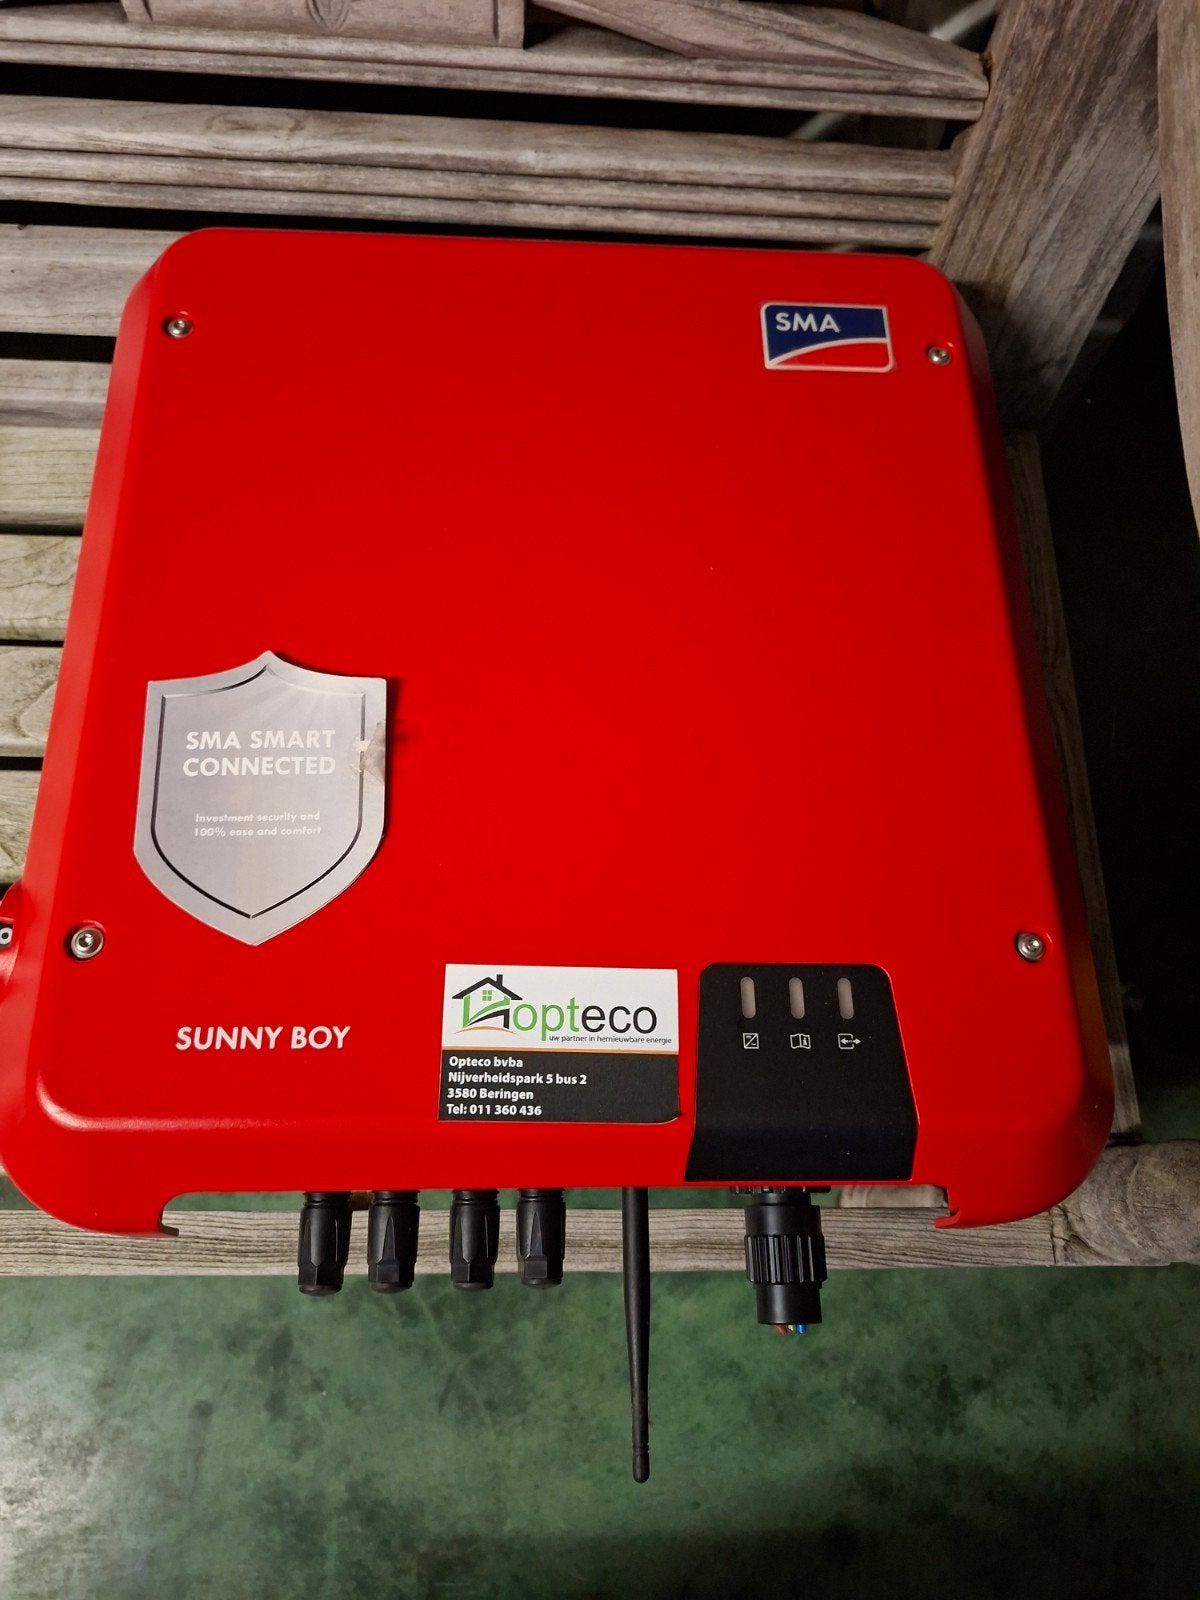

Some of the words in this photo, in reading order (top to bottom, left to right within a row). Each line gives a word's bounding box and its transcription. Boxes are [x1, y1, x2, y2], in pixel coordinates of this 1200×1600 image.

[775, 312, 841, 333] SMA
[186, 731, 241, 750] SMA
[250, 730, 336, 749] SMART
[182, 756, 336, 777] CONNECTED
[195, 813, 254, 823] Investment
[257, 812, 297, 823] security
[300, 811, 320, 821] and
[194, 827, 226, 837] 100%
[229, 828, 255, 836] ease
[257, 827, 277, 836] and
[281, 826, 322, 835] comfort
[512, 996, 657, 1042] opteco
[176, 1026, 283, 1050] SUNNY
[291, 1025, 351, 1050] BOY
[561, 1035, 587, 1044] partner
[597, 1035, 645, 1044] hernieuwbare
[646, 1037, 672, 1045] energie
[449, 1056, 491, 1070] Opteco
[494, 1056, 523, 1068] bvba
[448, 1072, 543, 1086] Nijverheidspark
[546, 1074, 554, 1084] 5
[556, 1073, 577, 1085] bus
[579, 1075, 587, 1085] 2
[447, 1088, 477, 1100] 3580
[479, 1088, 534, 1102] Beringen
[446, 1104, 468, 1115] Tel:
[469, 1104, 491, 1115] 011
[494, 1104, 517, 1116] 360
[519, 1105, 542, 1116] 436
